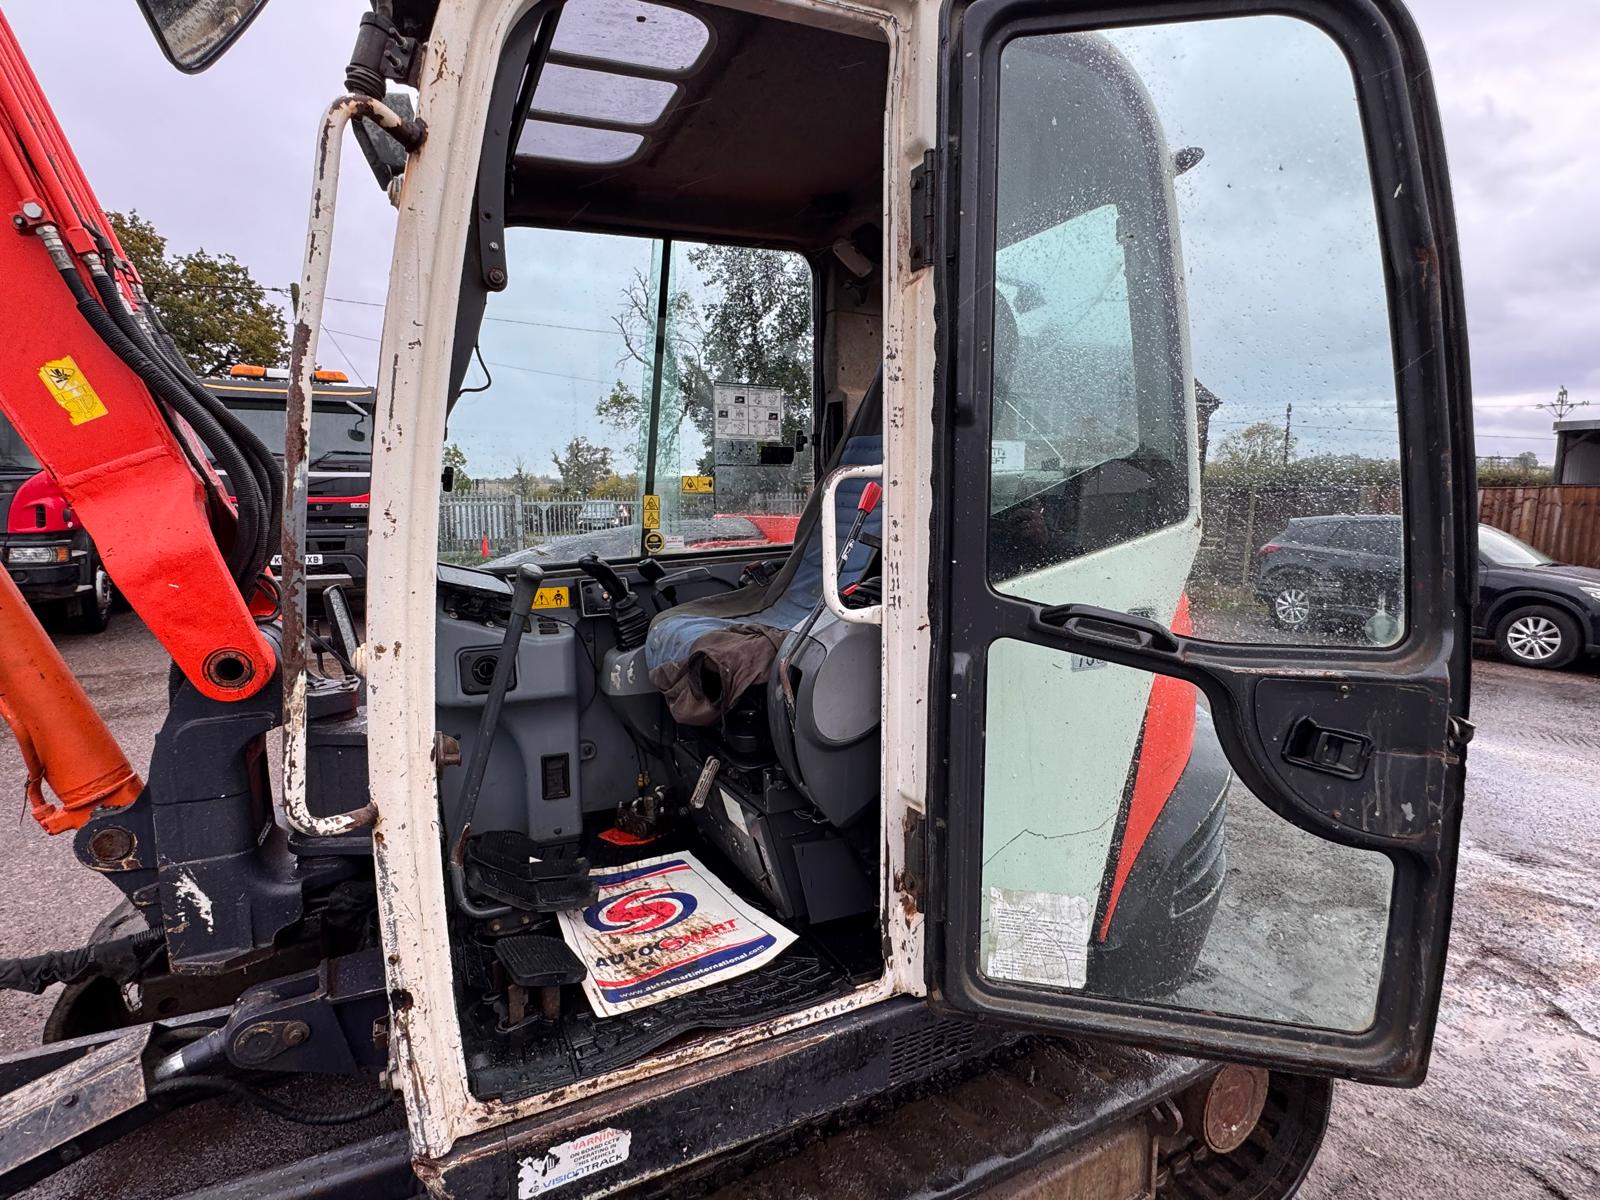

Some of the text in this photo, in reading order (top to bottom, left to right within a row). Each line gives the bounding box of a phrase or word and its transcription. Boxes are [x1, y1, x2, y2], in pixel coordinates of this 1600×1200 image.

[618, 944, 766, 999] www.autosmartinternational.com
[573, 1146, 609, 1163] OPERATING
[581, 1143, 603, 1155] BOARD
[590, 1149, 616, 1162] VEHICLE
[542, 1153, 623, 1188] VISIONTRACK
